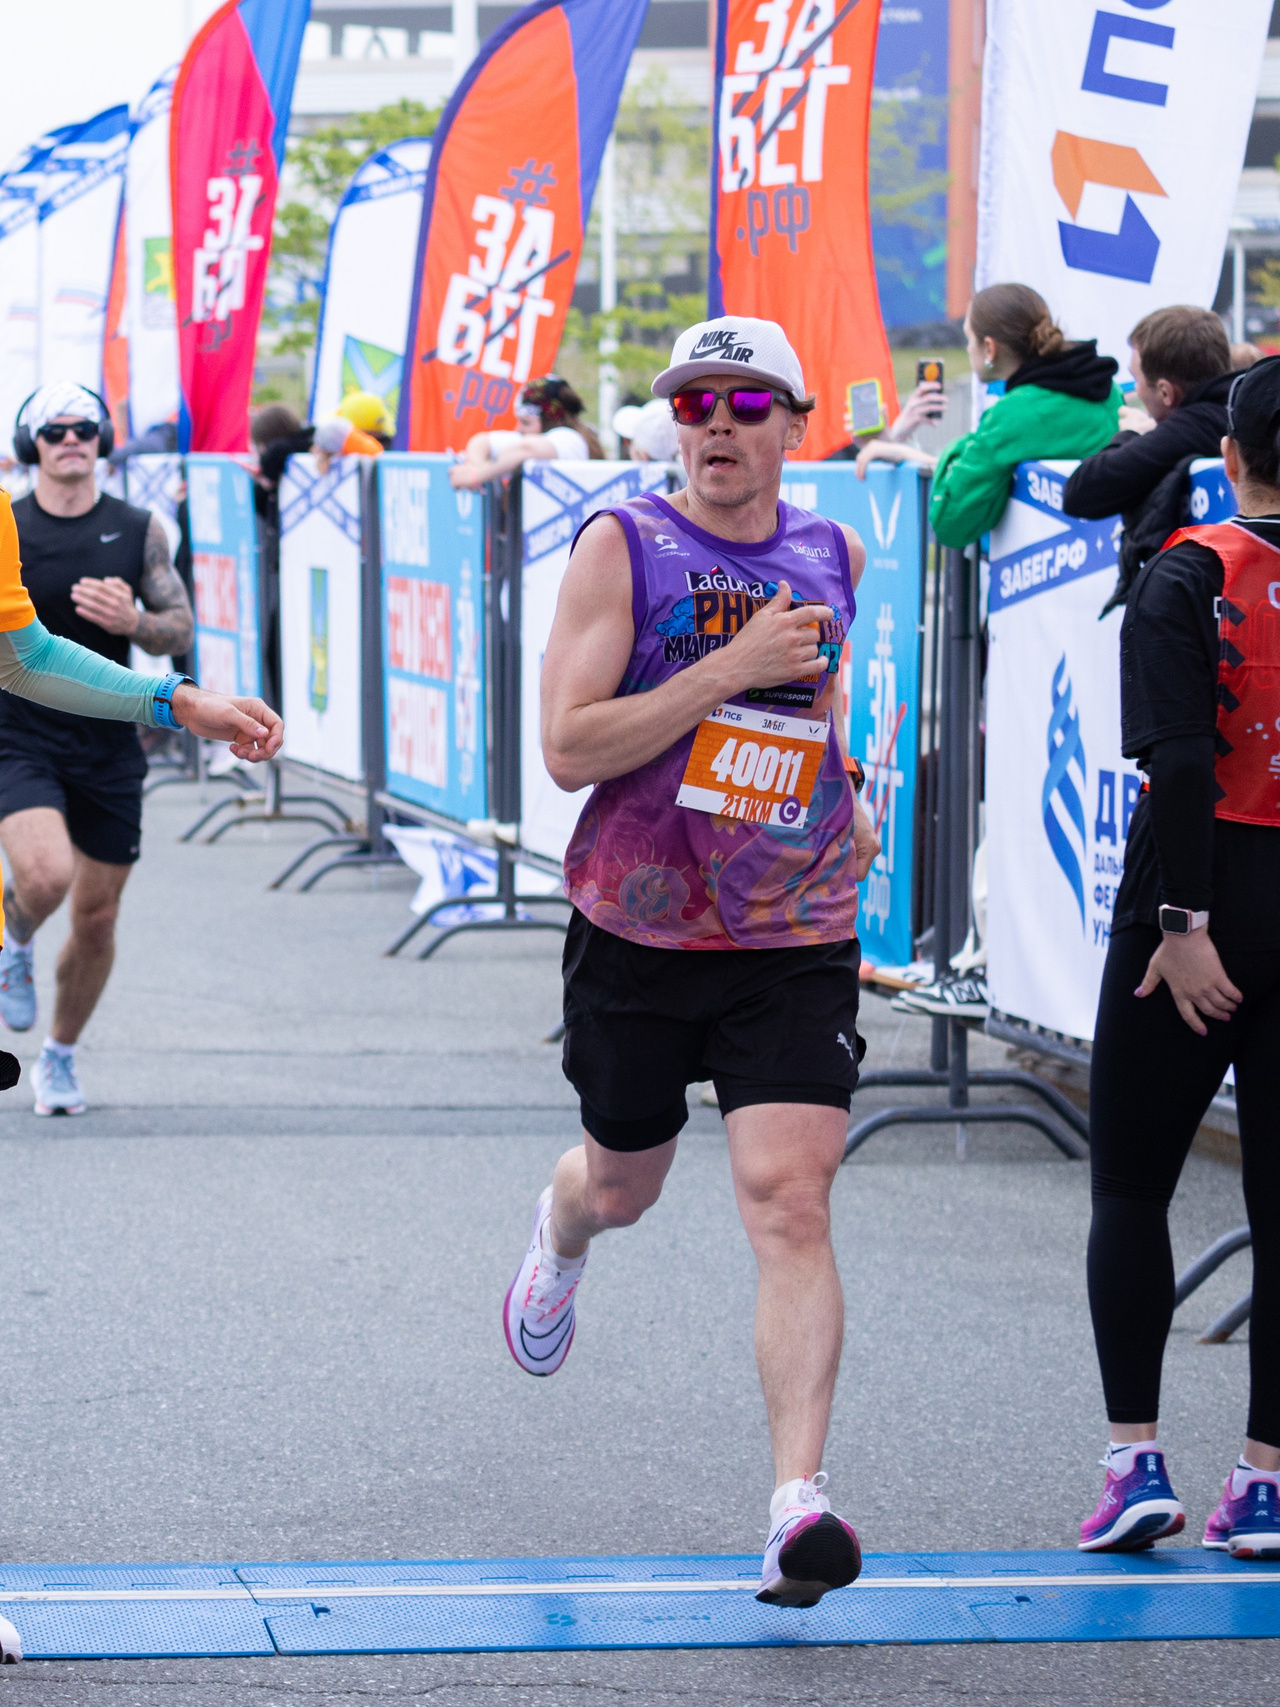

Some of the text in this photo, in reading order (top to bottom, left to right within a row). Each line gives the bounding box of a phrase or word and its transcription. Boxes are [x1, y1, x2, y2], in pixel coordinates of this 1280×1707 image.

[718, 65, 851, 193] БЕГ
[468, 193, 556, 299] ЗА
[436, 272, 556, 384] БЕГ
[697, 330, 738, 349] NIKE
[719, 344, 754, 364] AIR
[1000, 537, 1087, 598] ЗАБЕГ.РФ
[723, 711, 742, 722] ПСБ
[763, 690, 813, 702] SUPERSPORTS
[710, 737, 804, 795] 40011
